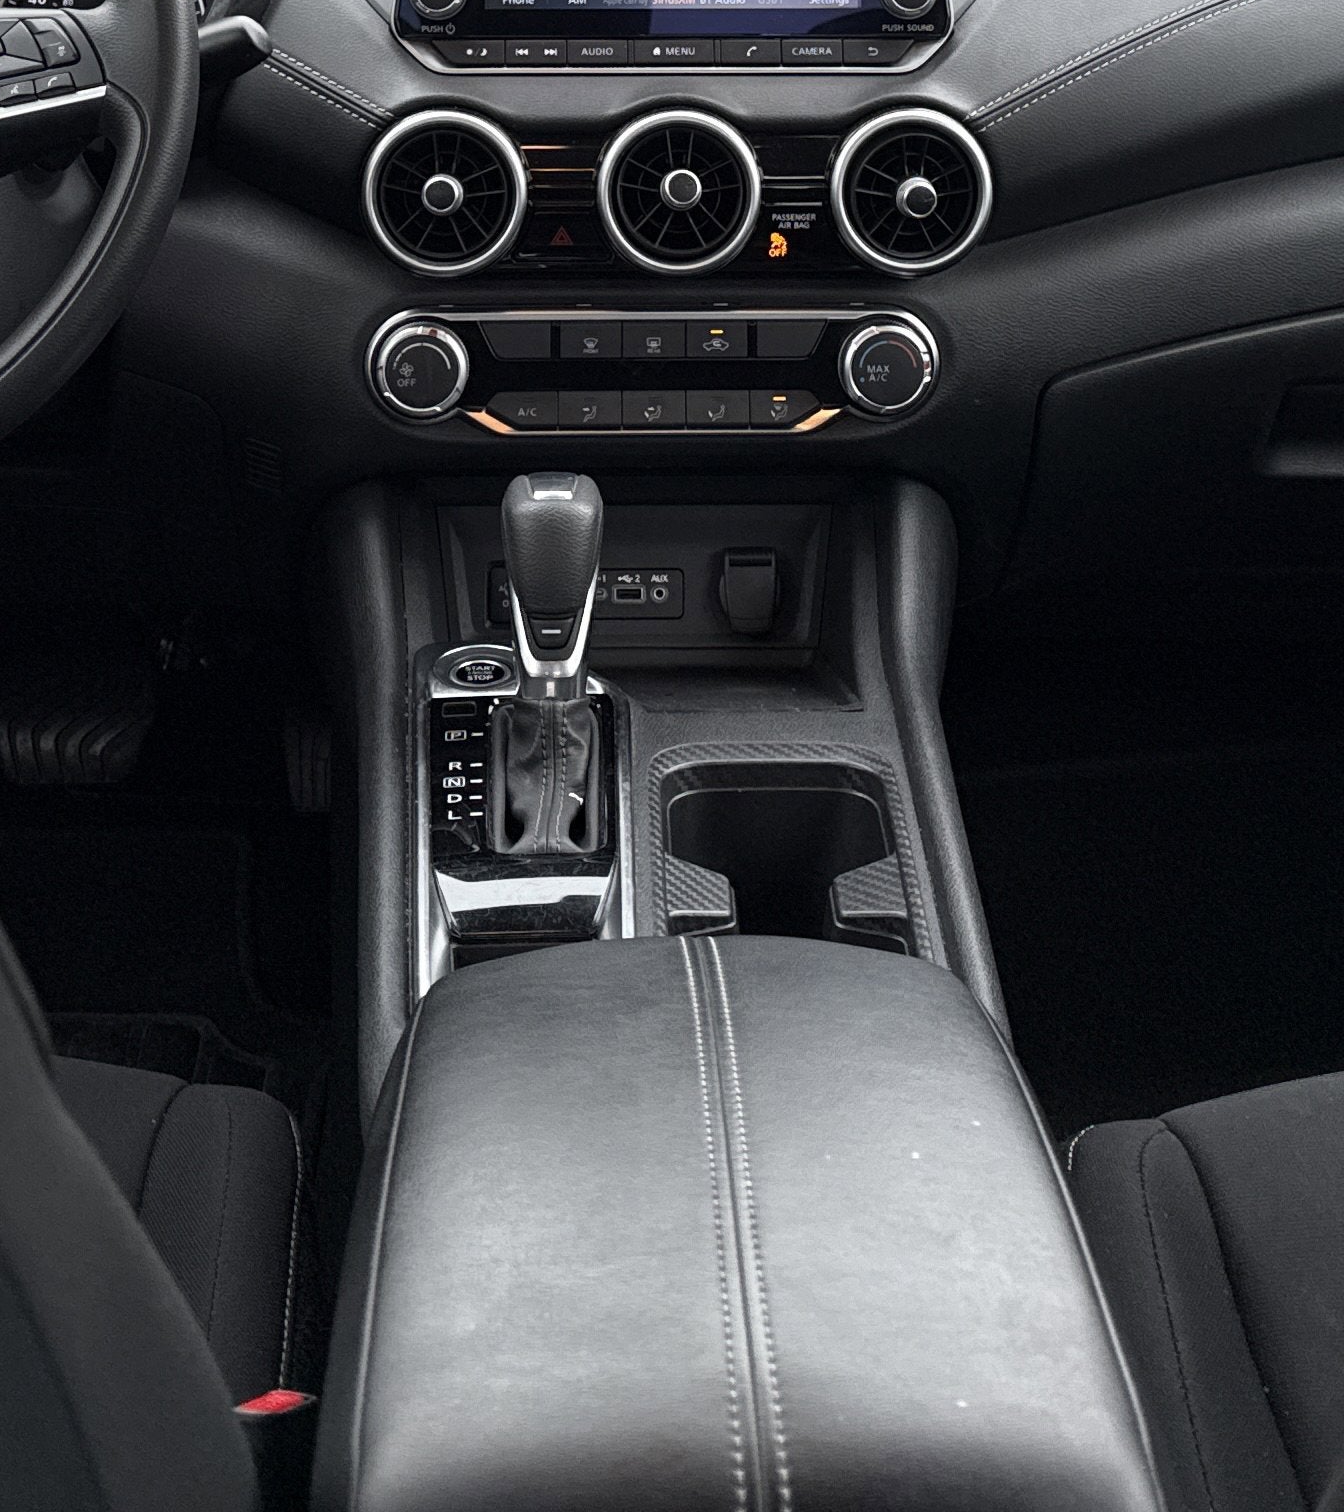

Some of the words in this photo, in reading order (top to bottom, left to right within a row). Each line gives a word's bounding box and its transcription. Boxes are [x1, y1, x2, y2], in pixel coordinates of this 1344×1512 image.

[421, 24, 444, 34] PUSH
[881, 23, 904, 32] PUSH
[907, 23, 935, 32] SOUND
[580, 46, 614, 57] AUDIO
[665, 46, 696, 56] MENU
[791, 46, 833, 56] CAMERA
[771, 213, 816, 221] PASSENGER
[778, 221, 792, 229] AIR
[793, 221, 810, 229] BAG
[768, 248, 787, 257] OFF
[866, 364, 890, 374] MAX
[396, 378, 416, 387] OFF
[868, 373, 888, 382] A/C
[517, 407, 537, 417] A/C
[650, 575, 669, 583] AUX
[448, 761, 462, 771] R
[447, 793, 463, 804] D
[447, 809, 463, 820] L
